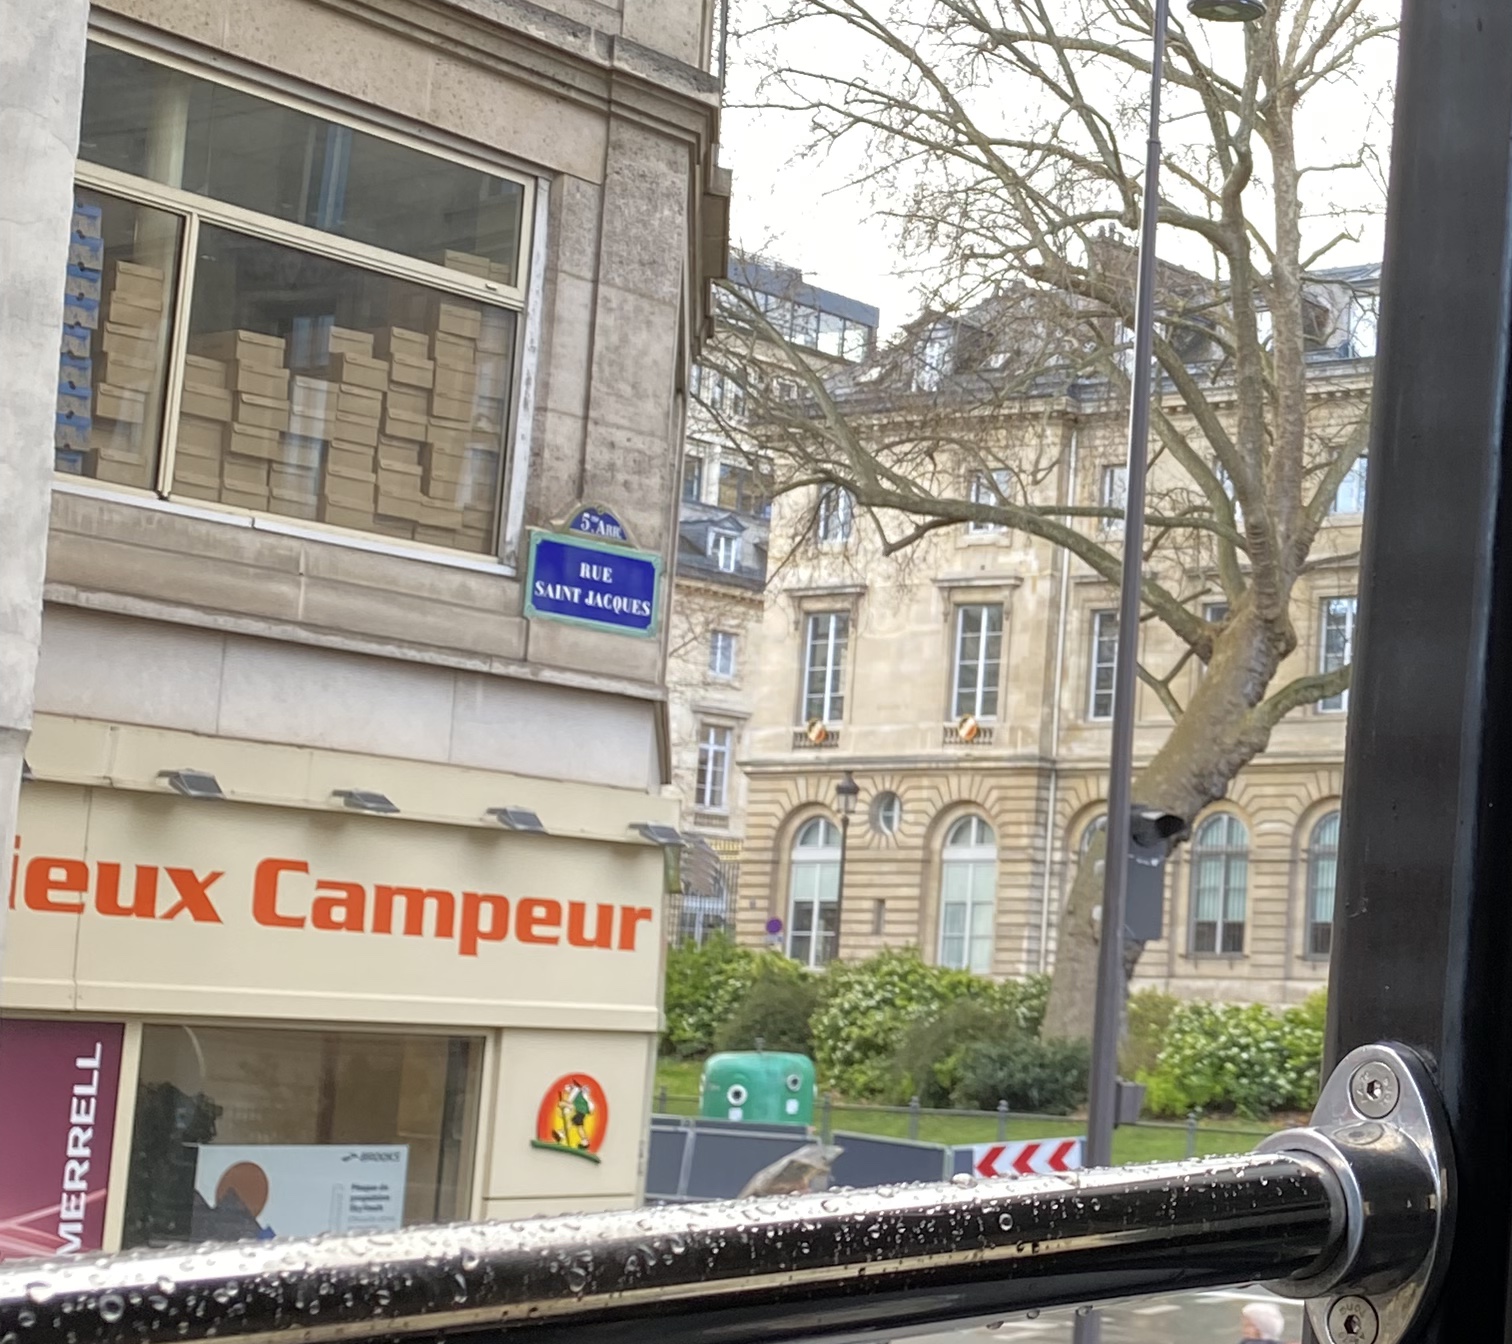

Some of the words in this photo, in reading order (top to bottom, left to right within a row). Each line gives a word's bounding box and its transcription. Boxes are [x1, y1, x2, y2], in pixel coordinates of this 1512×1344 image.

[535, 580, 582, 604] SAINT
[585, 590, 651, 616] JACQUES
[579, 562, 613, 584] RUE
[9, 834, 225, 924] eux
[251, 857, 653, 956] Campeur
[56, 1041, 103, 1255] MERRELL
